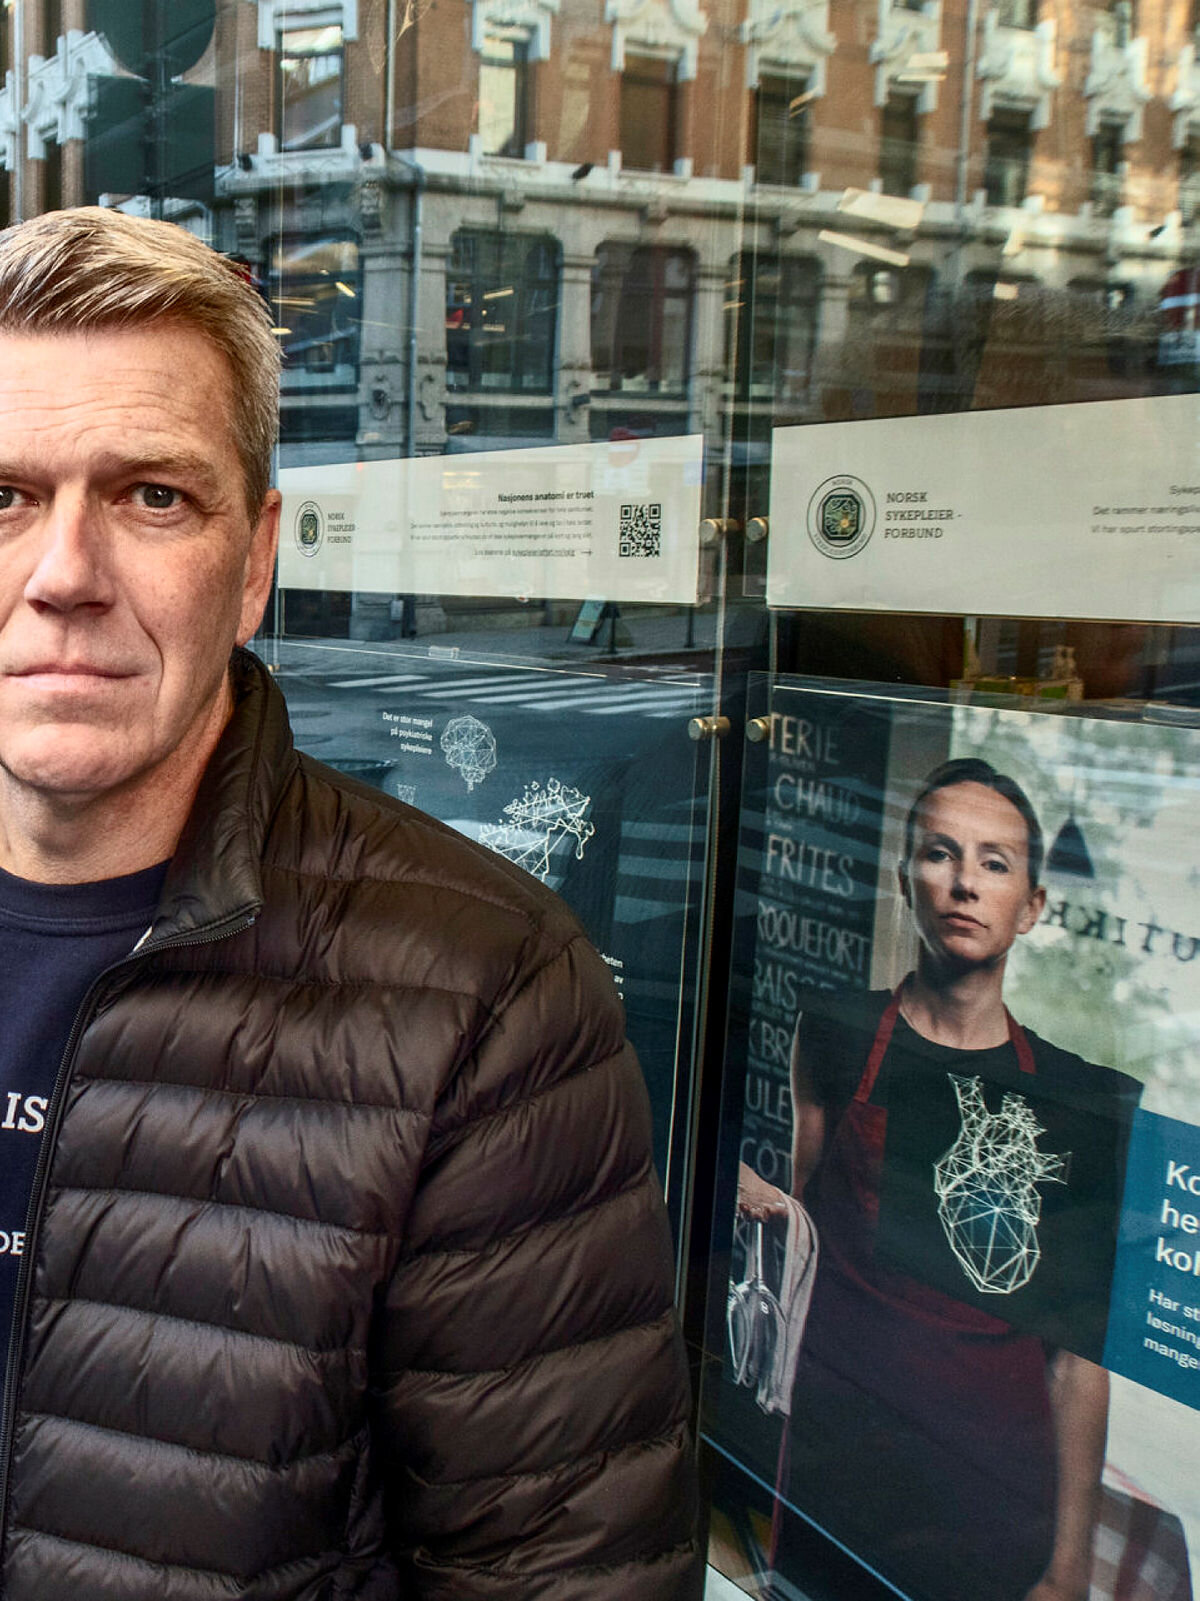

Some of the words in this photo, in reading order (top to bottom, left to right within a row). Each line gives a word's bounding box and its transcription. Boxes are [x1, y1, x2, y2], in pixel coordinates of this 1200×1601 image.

[535, 491, 564, 501] anatomi
[575, 490, 594, 500] truet
[886, 491, 928, 503] NORSK
[885, 509, 954, 521] SYKEPLEIER
[884, 527, 943, 538] FORBUND
[766, 833, 854, 897] FRITES
[1148, 1288, 1180, 1312] Har
